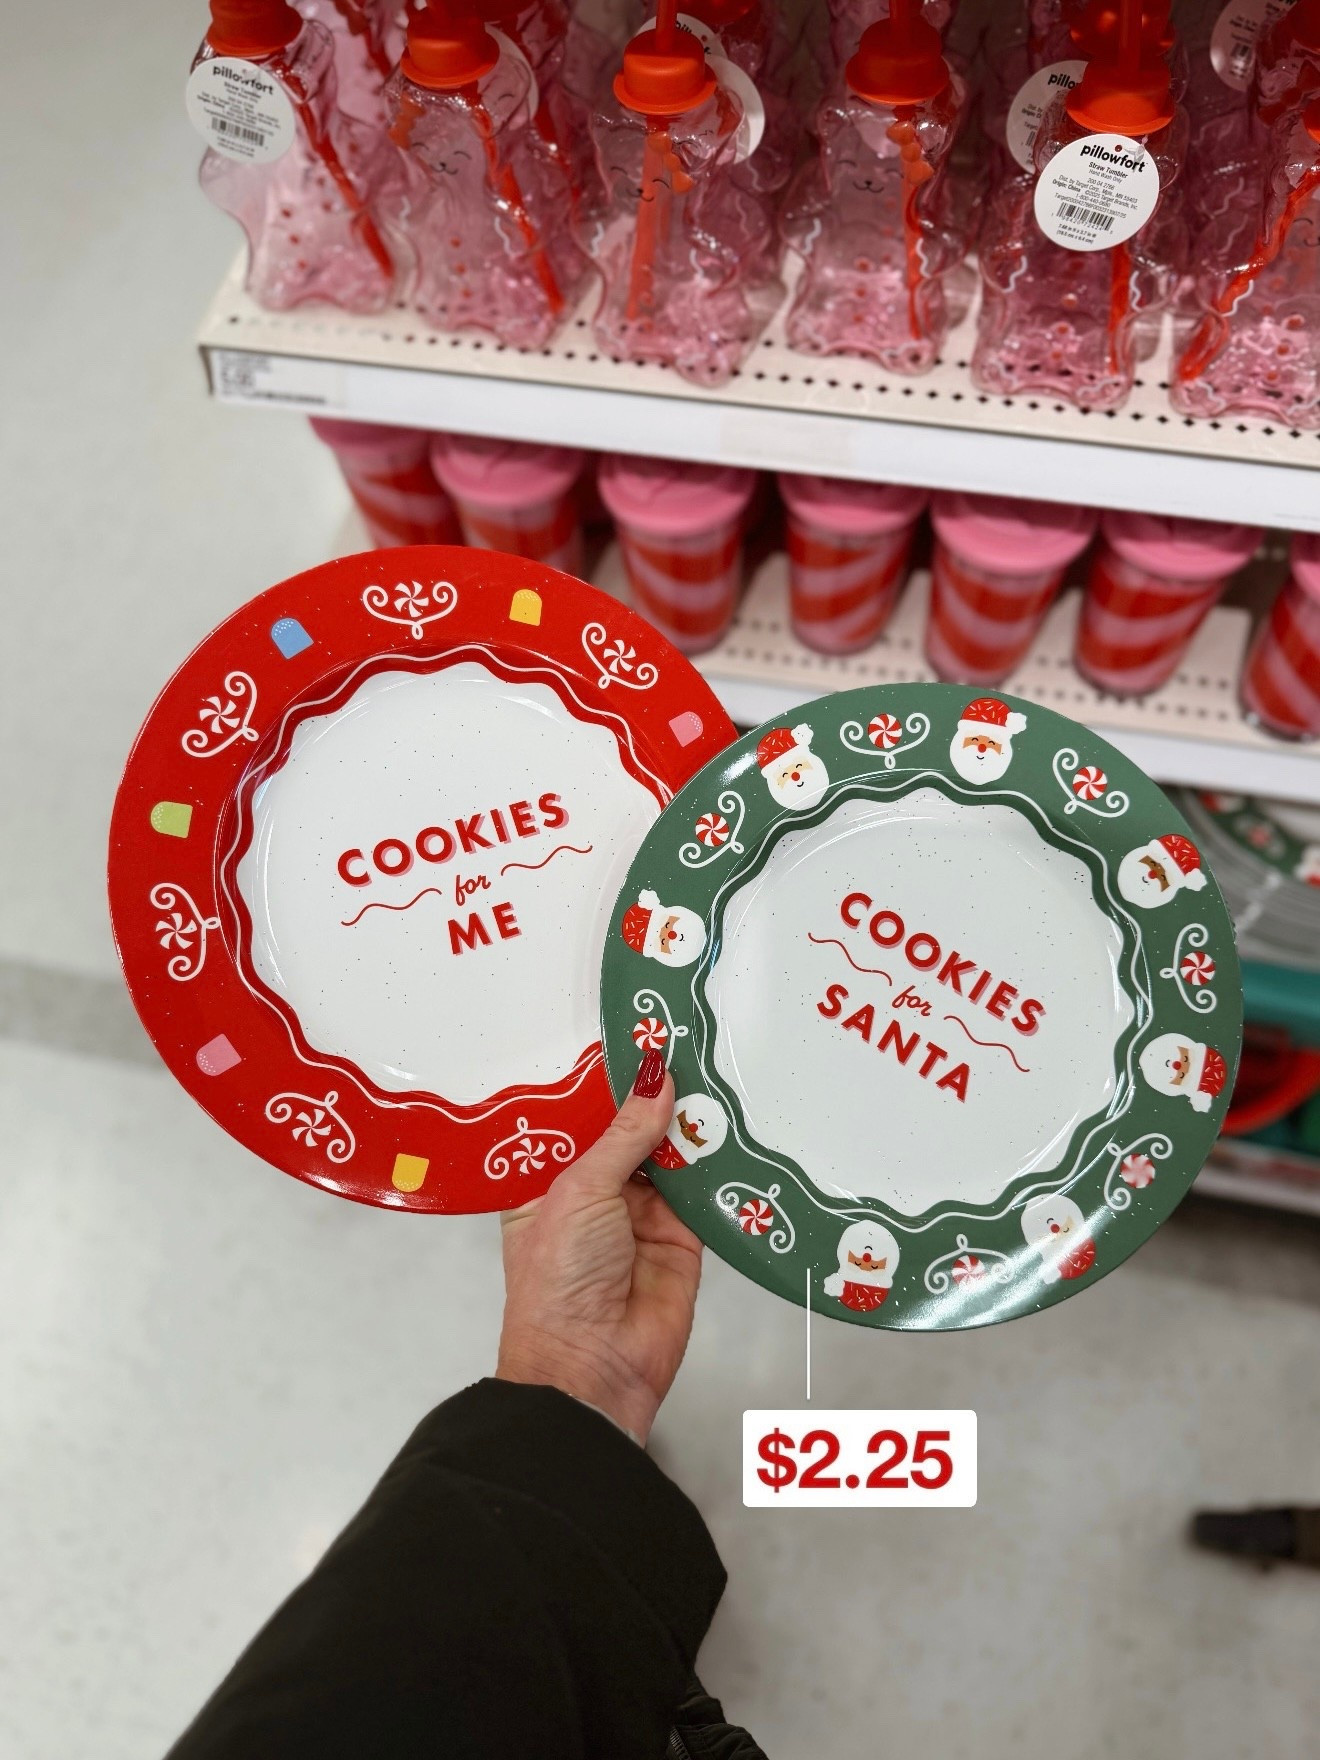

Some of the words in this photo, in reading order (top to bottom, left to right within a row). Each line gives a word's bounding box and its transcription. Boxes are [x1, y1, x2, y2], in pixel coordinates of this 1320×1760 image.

[1047, 73, 1077, 90] pillo
[1080, 144, 1145, 172] pillowfort
[1088, 161, 1105, 171] Straw
[1105, 166, 1128, 178] Tumbler
[1051, 179, 1067, 188] Origin:
[1067, 183, 1081, 192] China
[1100, 194, 1114, 203] Target
[1074, 180, 1089, 189] Target
[338, 793, 569, 887] COOKIES
[456, 875, 491, 906] for
[448, 902, 522, 956] ME
[841, 892, 1046, 1037] COOKIES
[892, 985, 933, 1016] for
[817, 984, 970, 1103] SANTA
